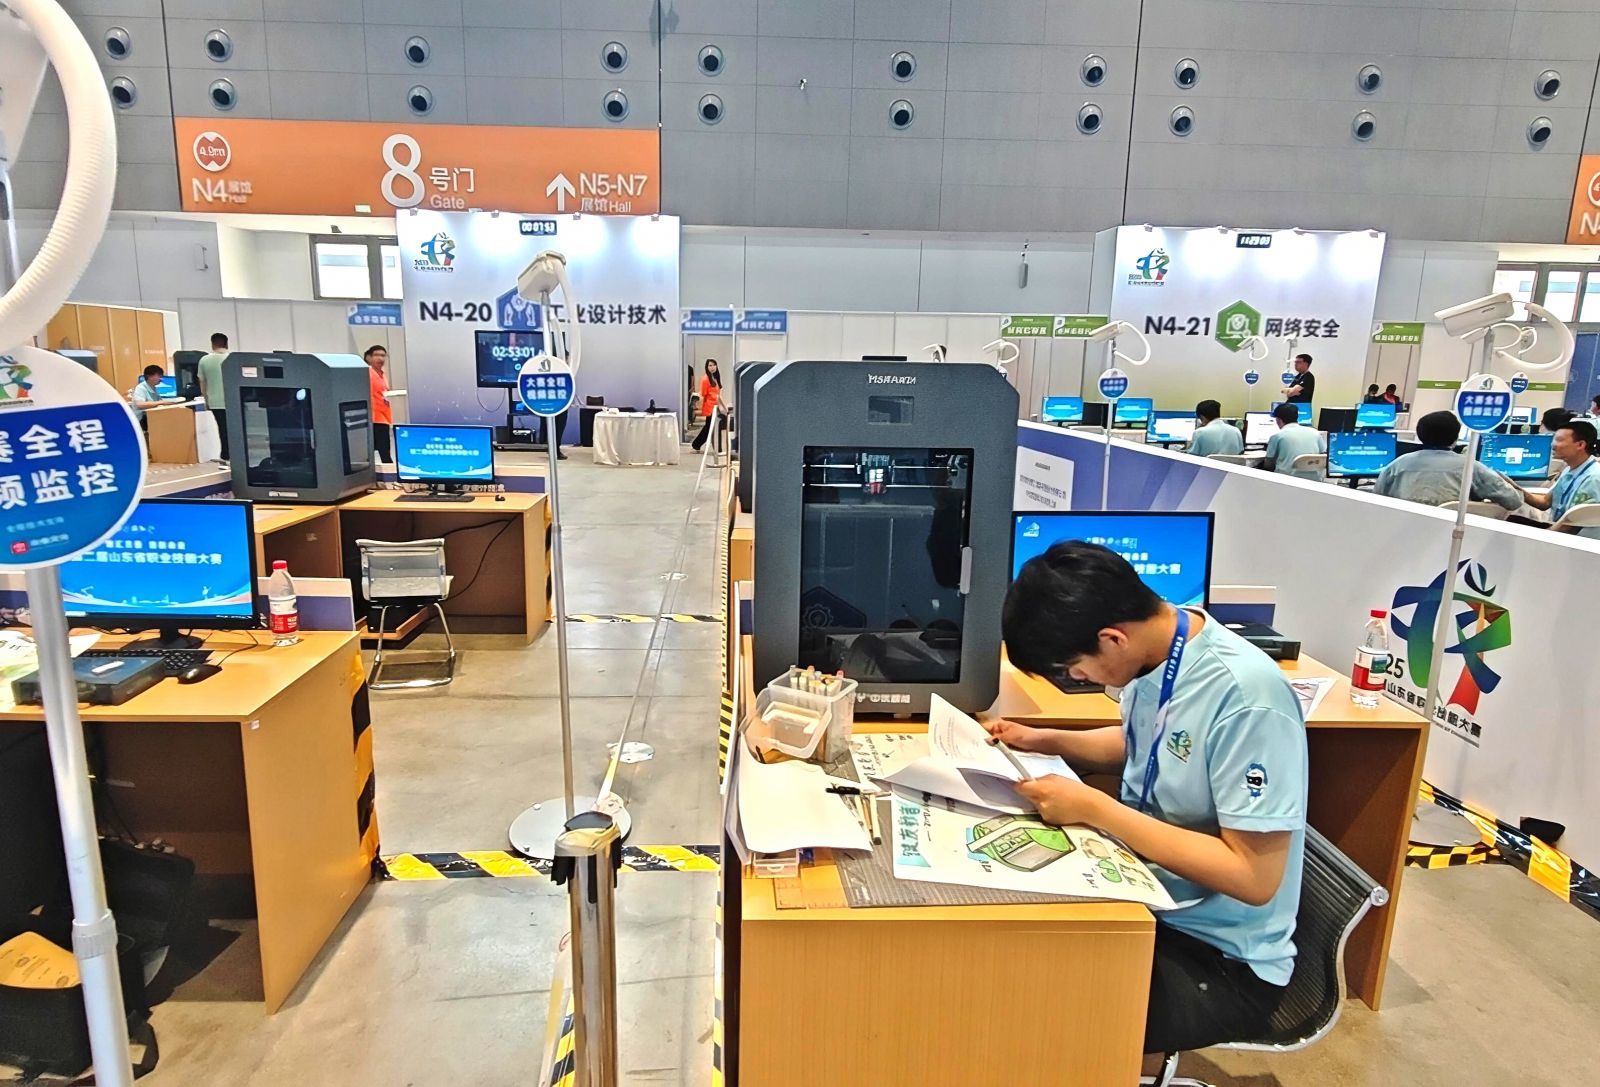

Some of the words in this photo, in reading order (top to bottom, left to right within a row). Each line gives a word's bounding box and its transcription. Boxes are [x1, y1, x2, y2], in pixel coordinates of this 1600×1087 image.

[381, 133, 425, 208] 8
[429, 167, 475, 193] 号门
[192, 178, 228, 203] N4
[579, 172, 648, 197] N5-N7
[430, 195, 465, 209] Gate
[609, 199, 631, 213] Hall
[1579, 211, 1600, 236] N
[420, 302, 492, 322] N4-20
[1145, 315, 1211, 336] N4-21
[1264, 318, 1340, 338] 网络安全
